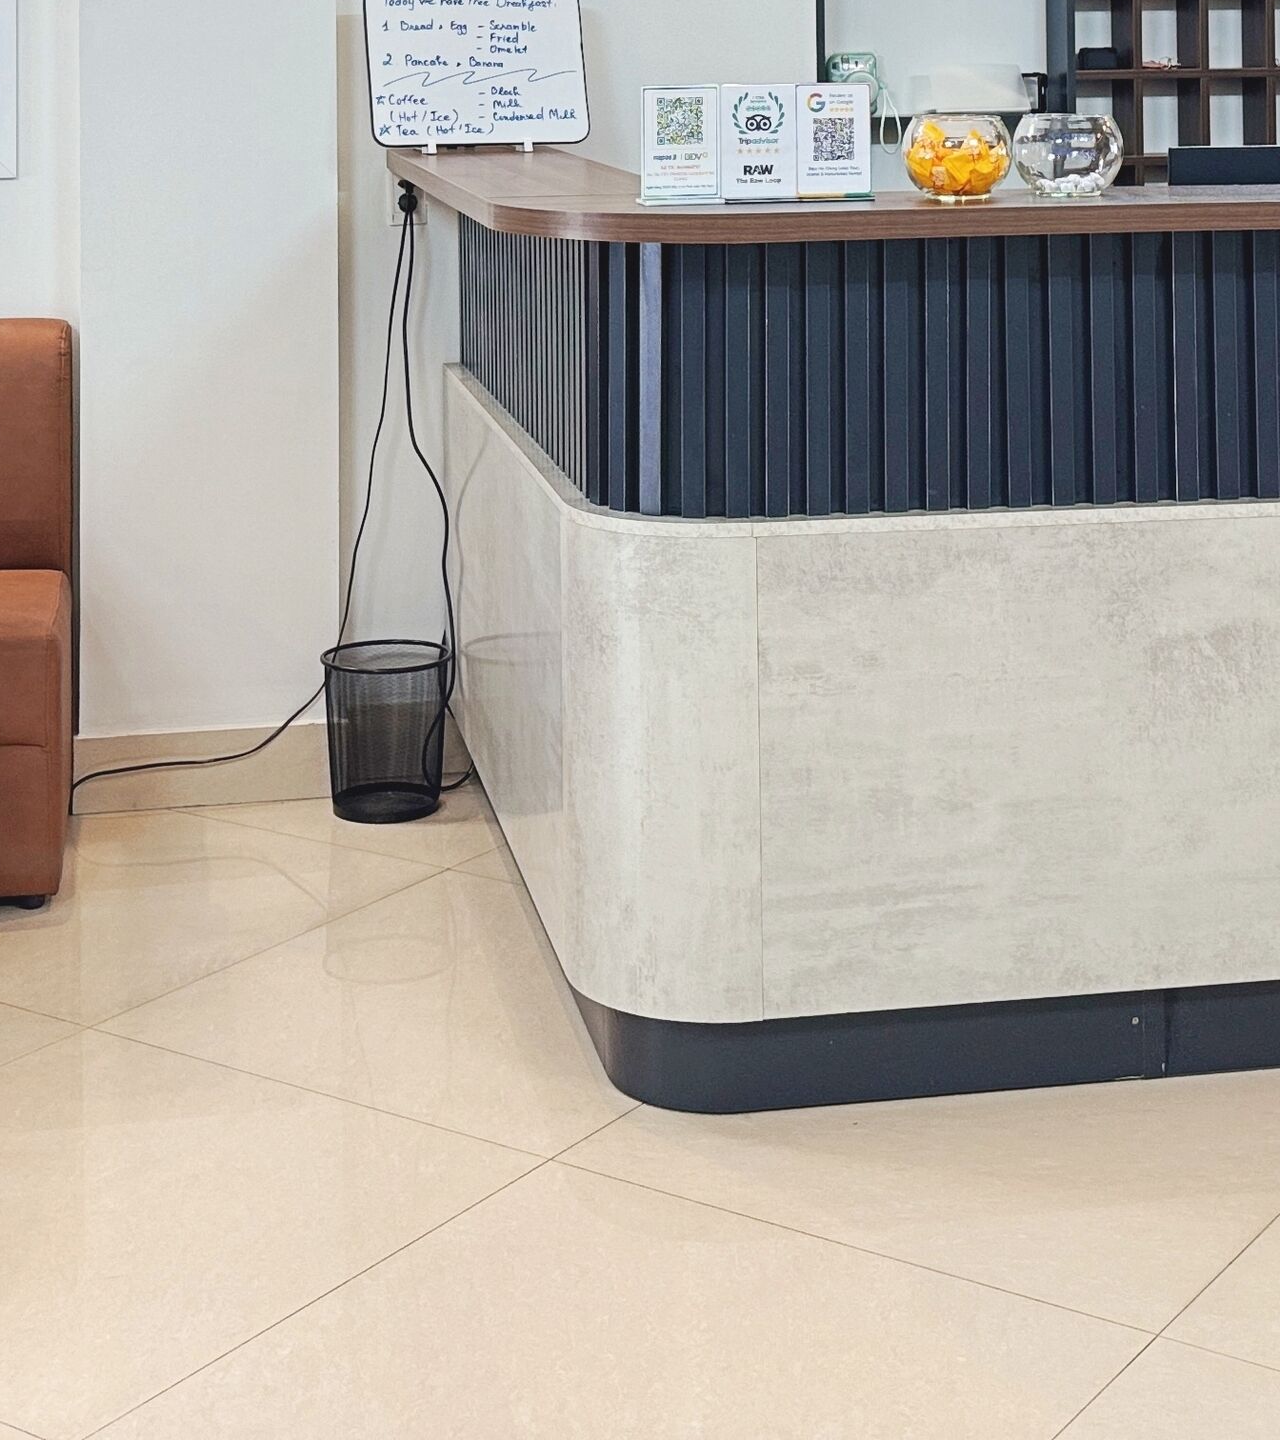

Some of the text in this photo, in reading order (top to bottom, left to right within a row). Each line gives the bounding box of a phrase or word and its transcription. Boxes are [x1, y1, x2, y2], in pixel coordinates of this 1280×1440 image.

[400, 19, 434, 31] Bread
[450, 21, 468, 35] Egg
[489, 20, 537, 32] Scramble
[489, 32, 519, 44] Fried
[405, 54, 449, 67] Pancake
[469, 56, 504, 68] Banana
[388, 94, 429, 105] Coffee
[493, 100, 523, 108] Milk
[493, 107, 577, 122] Condensed Milk
[397, 125, 419, 136] Tea
[743, 164, 774, 175] RAW
